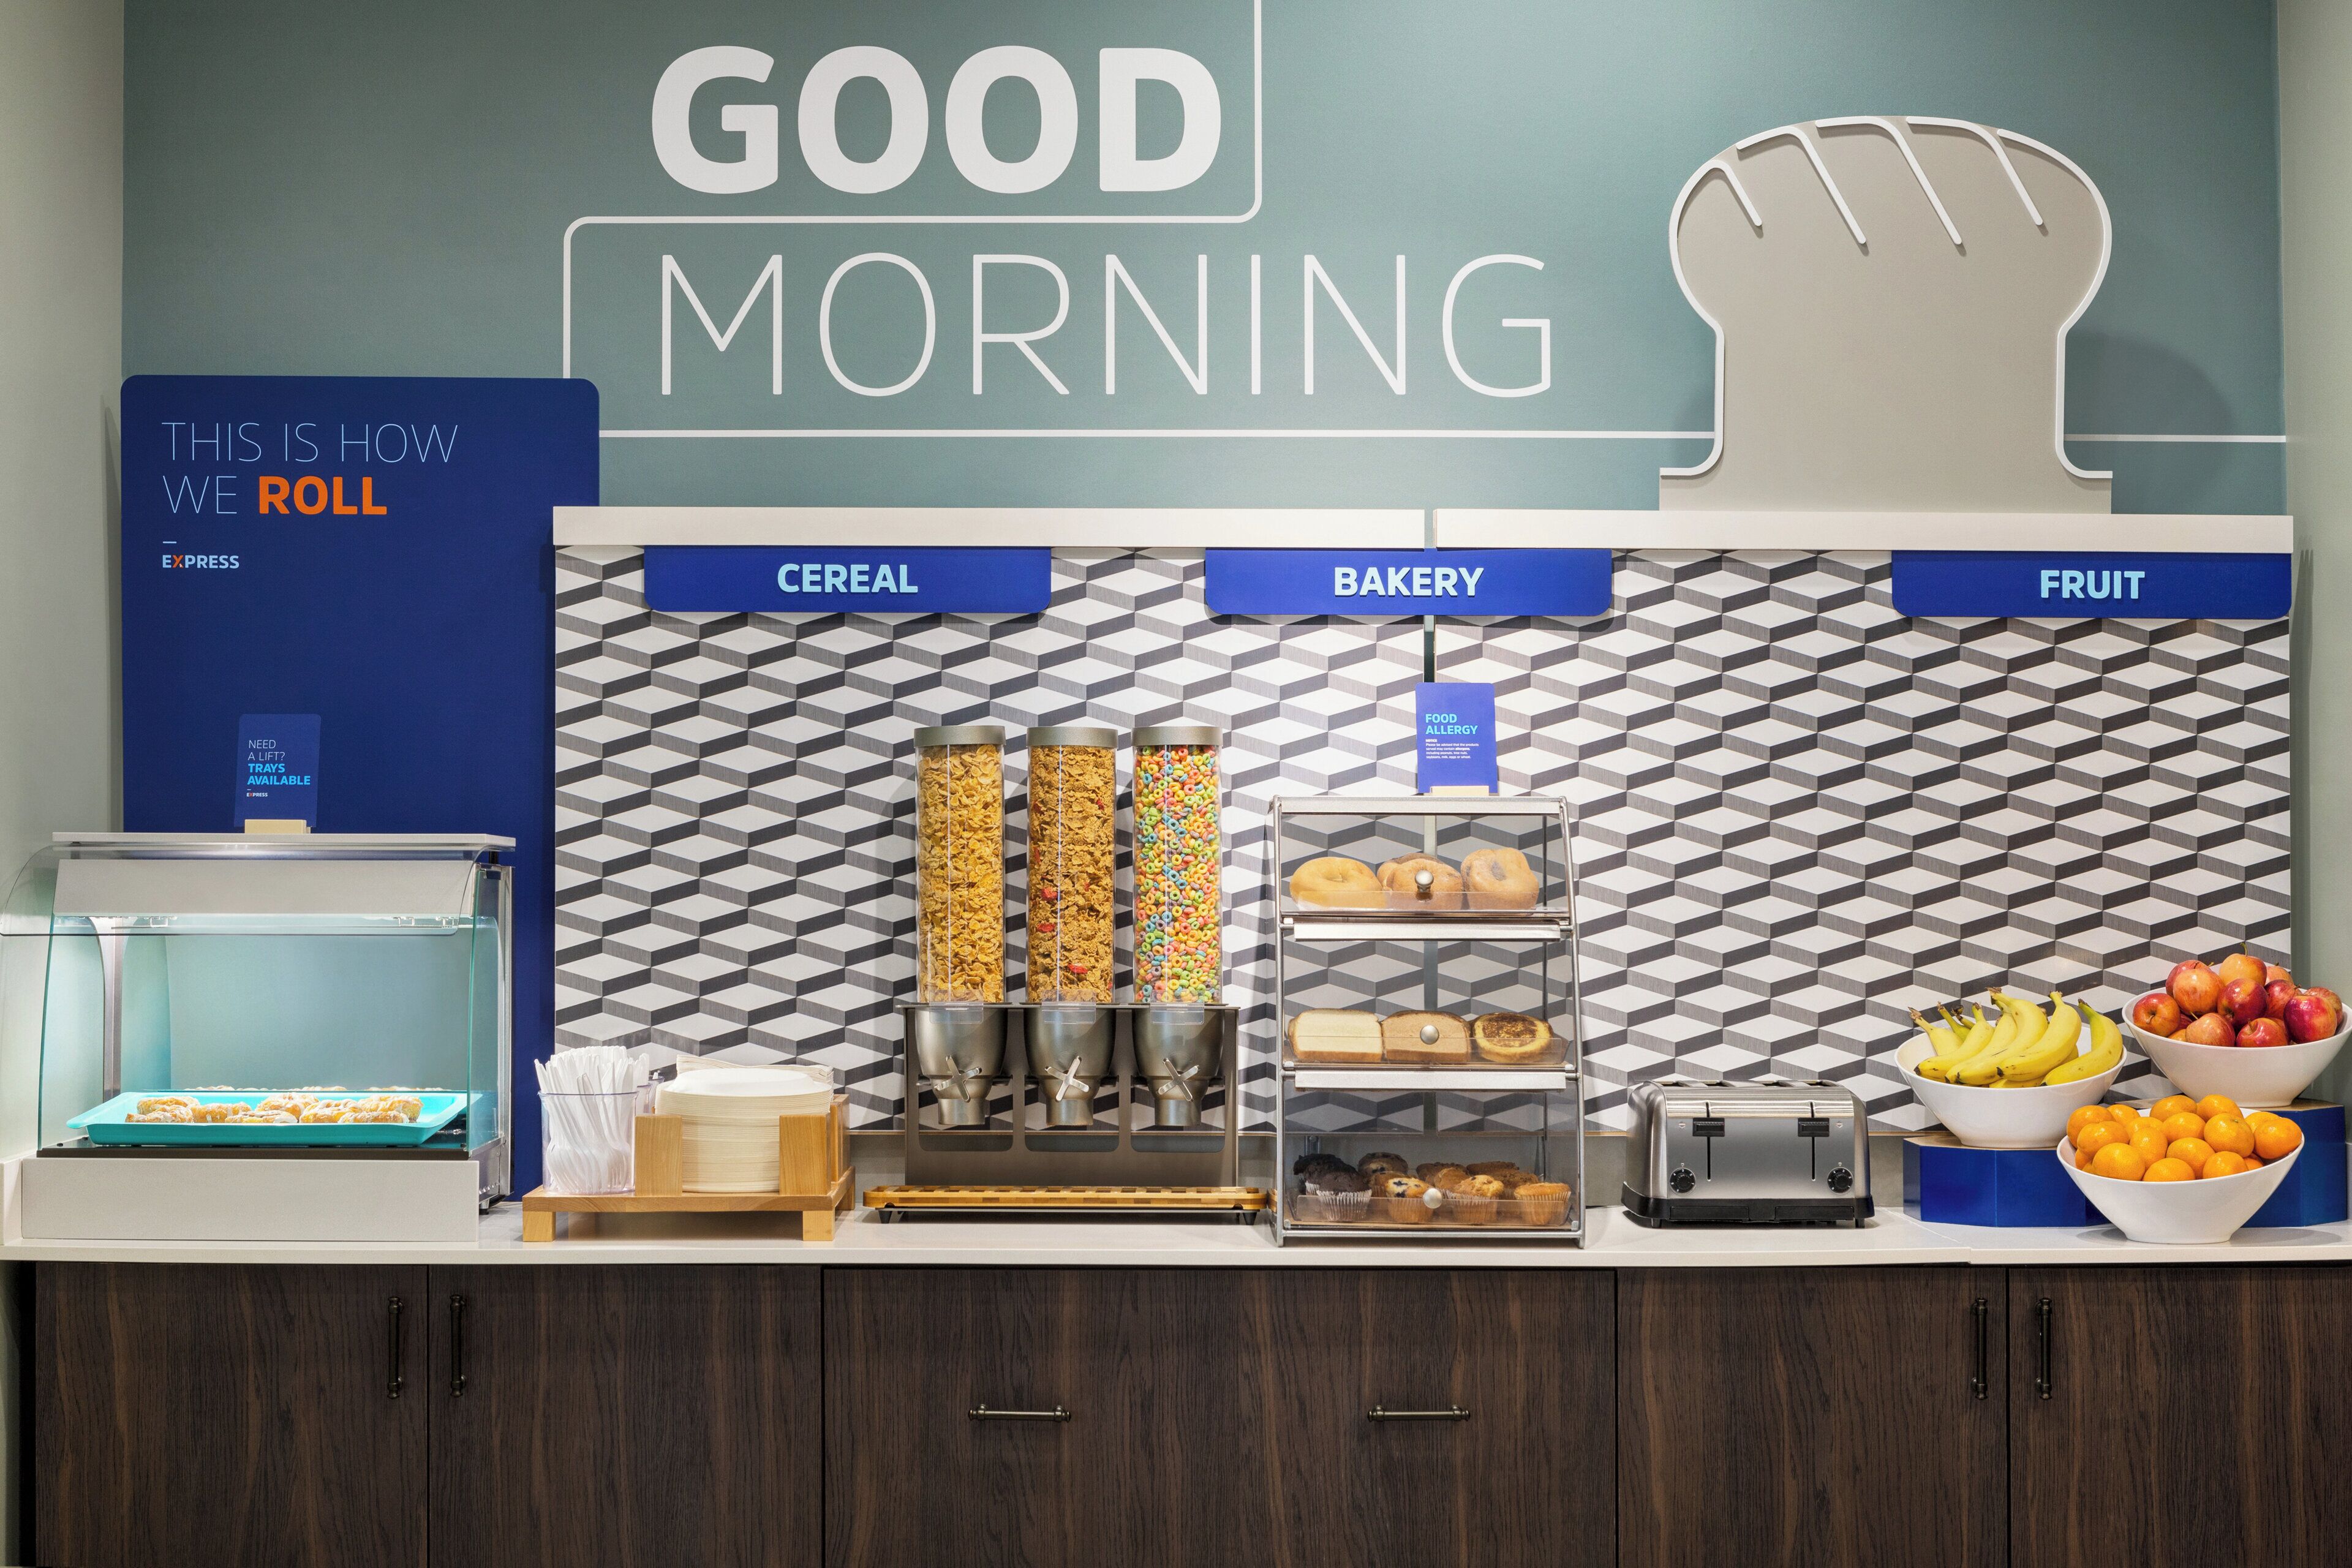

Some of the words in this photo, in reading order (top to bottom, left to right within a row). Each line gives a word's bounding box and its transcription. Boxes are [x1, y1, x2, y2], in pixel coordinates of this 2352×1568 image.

[652, 45, 1221, 194] GOOD
[662, 252, 1551, 398] MORNING
[162, 422, 262, 462] THIS
[285, 423, 318, 462] IS
[341, 423, 458, 463] HOW
[162, 475, 238, 514] WE
[259, 475, 387, 515] ROLL
[162, 554, 239, 569] EXPRESS
[777, 563, 918, 594] CEREAL
[1334, 567, 1484, 597] BAKERY
[2040, 570, 2145, 600] FRUIT
[1425, 714, 1457, 723] FOOD
[1425, 725, 1478, 735] ALLERGY
[249, 739, 276, 749] NEED
[247, 752, 255, 761] A
[258, 752, 285, 761] LIFT?
[247, 763, 285, 773] TRAYS
[247, 775, 311, 785] AVAILABLE
